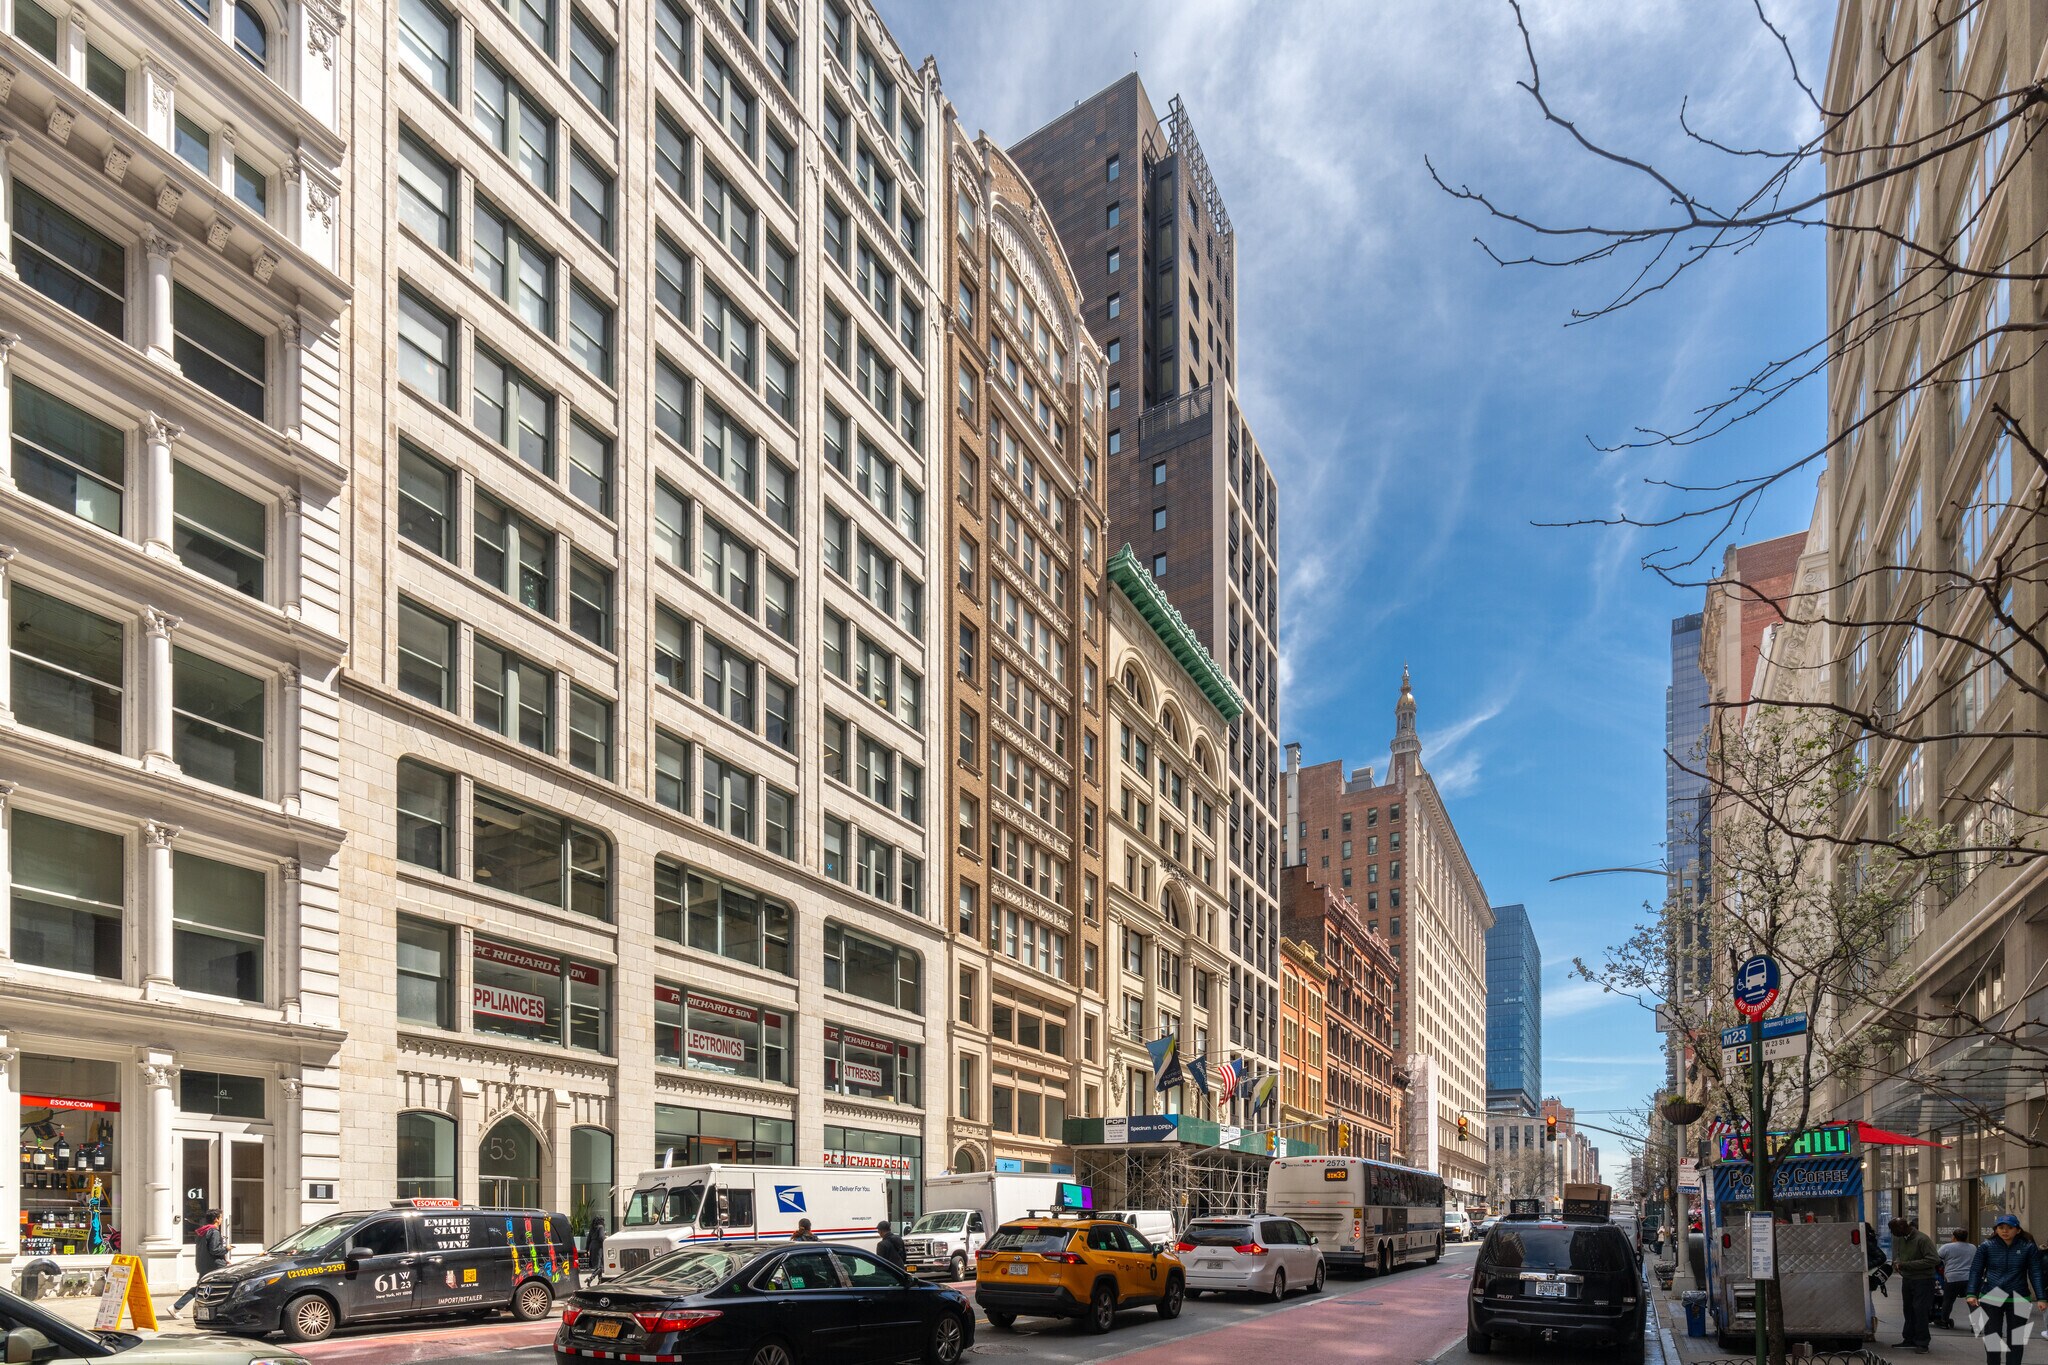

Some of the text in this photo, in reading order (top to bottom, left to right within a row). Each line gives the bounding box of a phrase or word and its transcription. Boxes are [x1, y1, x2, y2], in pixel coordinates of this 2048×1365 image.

[493, 949, 552, 971] RICHARD
[553, 965, 560, 973] &
[570, 968, 587, 979] ON
[473, 988, 544, 1018] PPLIANCES
[687, 998, 727, 1013] RICHARD
[735, 1010, 752, 1019] SON
[1737, 991, 1774, 1013] NO STANDING
[1785, 1016, 1795, 1024] East
[1795, 1014, 1805, 1023] Side
[687, 1032, 742, 1057] LECTRONICS
[1724, 1029, 1747, 1045] M23
[875, 1043, 888, 1051] SON
[845, 1064, 880, 1082] ATTRESSES
[50, 1099, 94, 1108] ESOW.COM
[490, 1137, 517, 1160] 53
[824, 1153, 911, 1169] P.C. RICHARD & SON
[1794, 1168, 1849, 1184] COFFEE
[188, 1188, 204, 1199] 61
[2008, 1181, 2026, 1213] 50
[424, 1218, 470, 1227] EMPIRE
[434, 1226, 470, 1235] STATE
[437, 1240, 470, 1249] WINE
[287, 1263, 346, 1279] (212)888-2297
[399, 1271, 411, 1280] W
[374, 1273, 399, 1292] 61
[400, 1281, 411, 1289] 23
[438, 1294, 483, 1305] IMPORT/RETAILER
